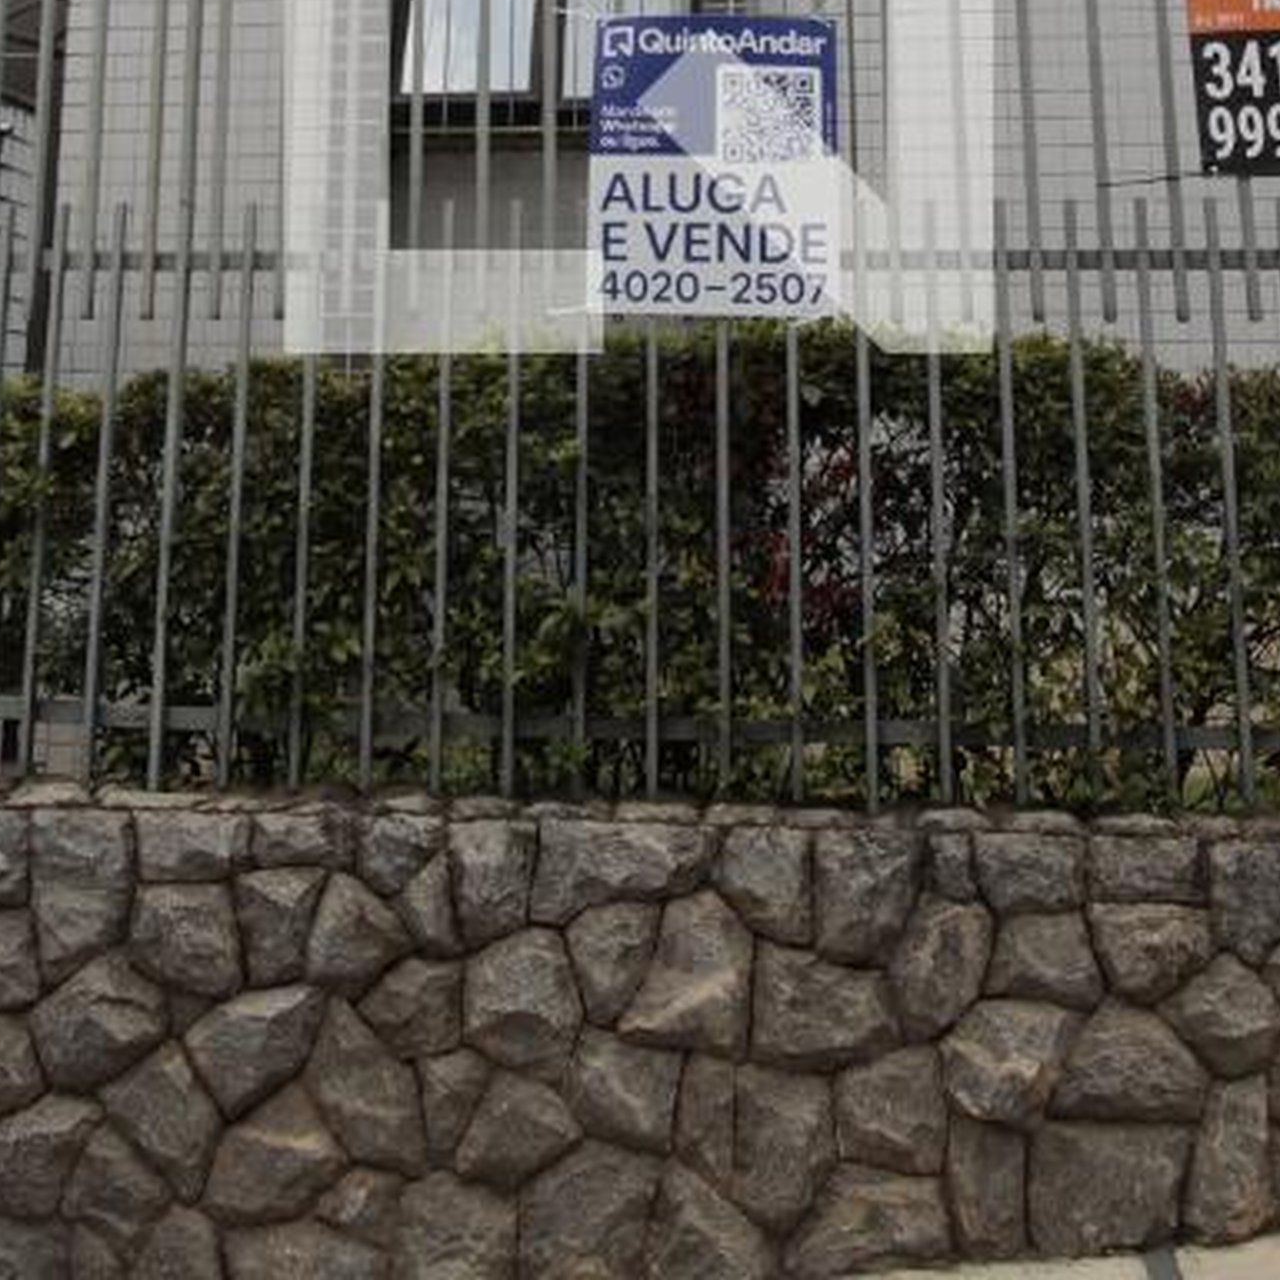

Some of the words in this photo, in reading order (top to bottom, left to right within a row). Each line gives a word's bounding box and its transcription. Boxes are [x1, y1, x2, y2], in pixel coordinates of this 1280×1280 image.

[638, 27, 827, 54] QuintoAndar
[600, 173, 788, 214] ALUGA
[602, 222, 629, 262] E
[644, 222, 828, 263] VENDE
[599, 271, 827, 305] 4020-2507
